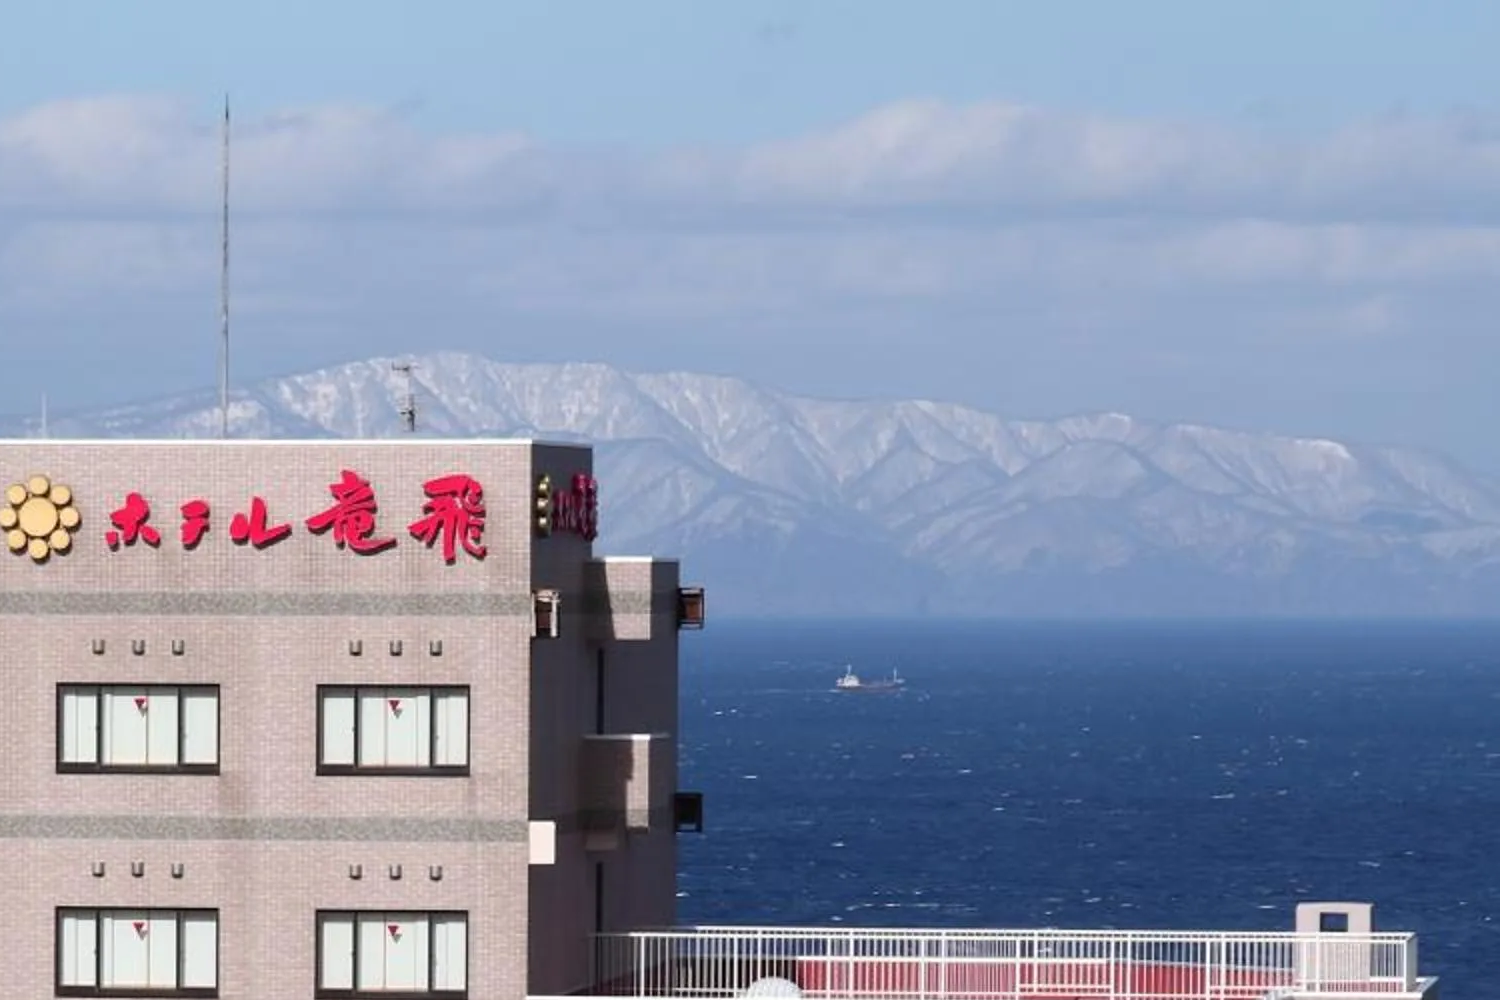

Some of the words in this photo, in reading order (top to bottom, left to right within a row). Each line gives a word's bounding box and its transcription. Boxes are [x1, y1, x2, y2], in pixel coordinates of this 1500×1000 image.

[105, 470, 487, 564] ホテル竜飛
